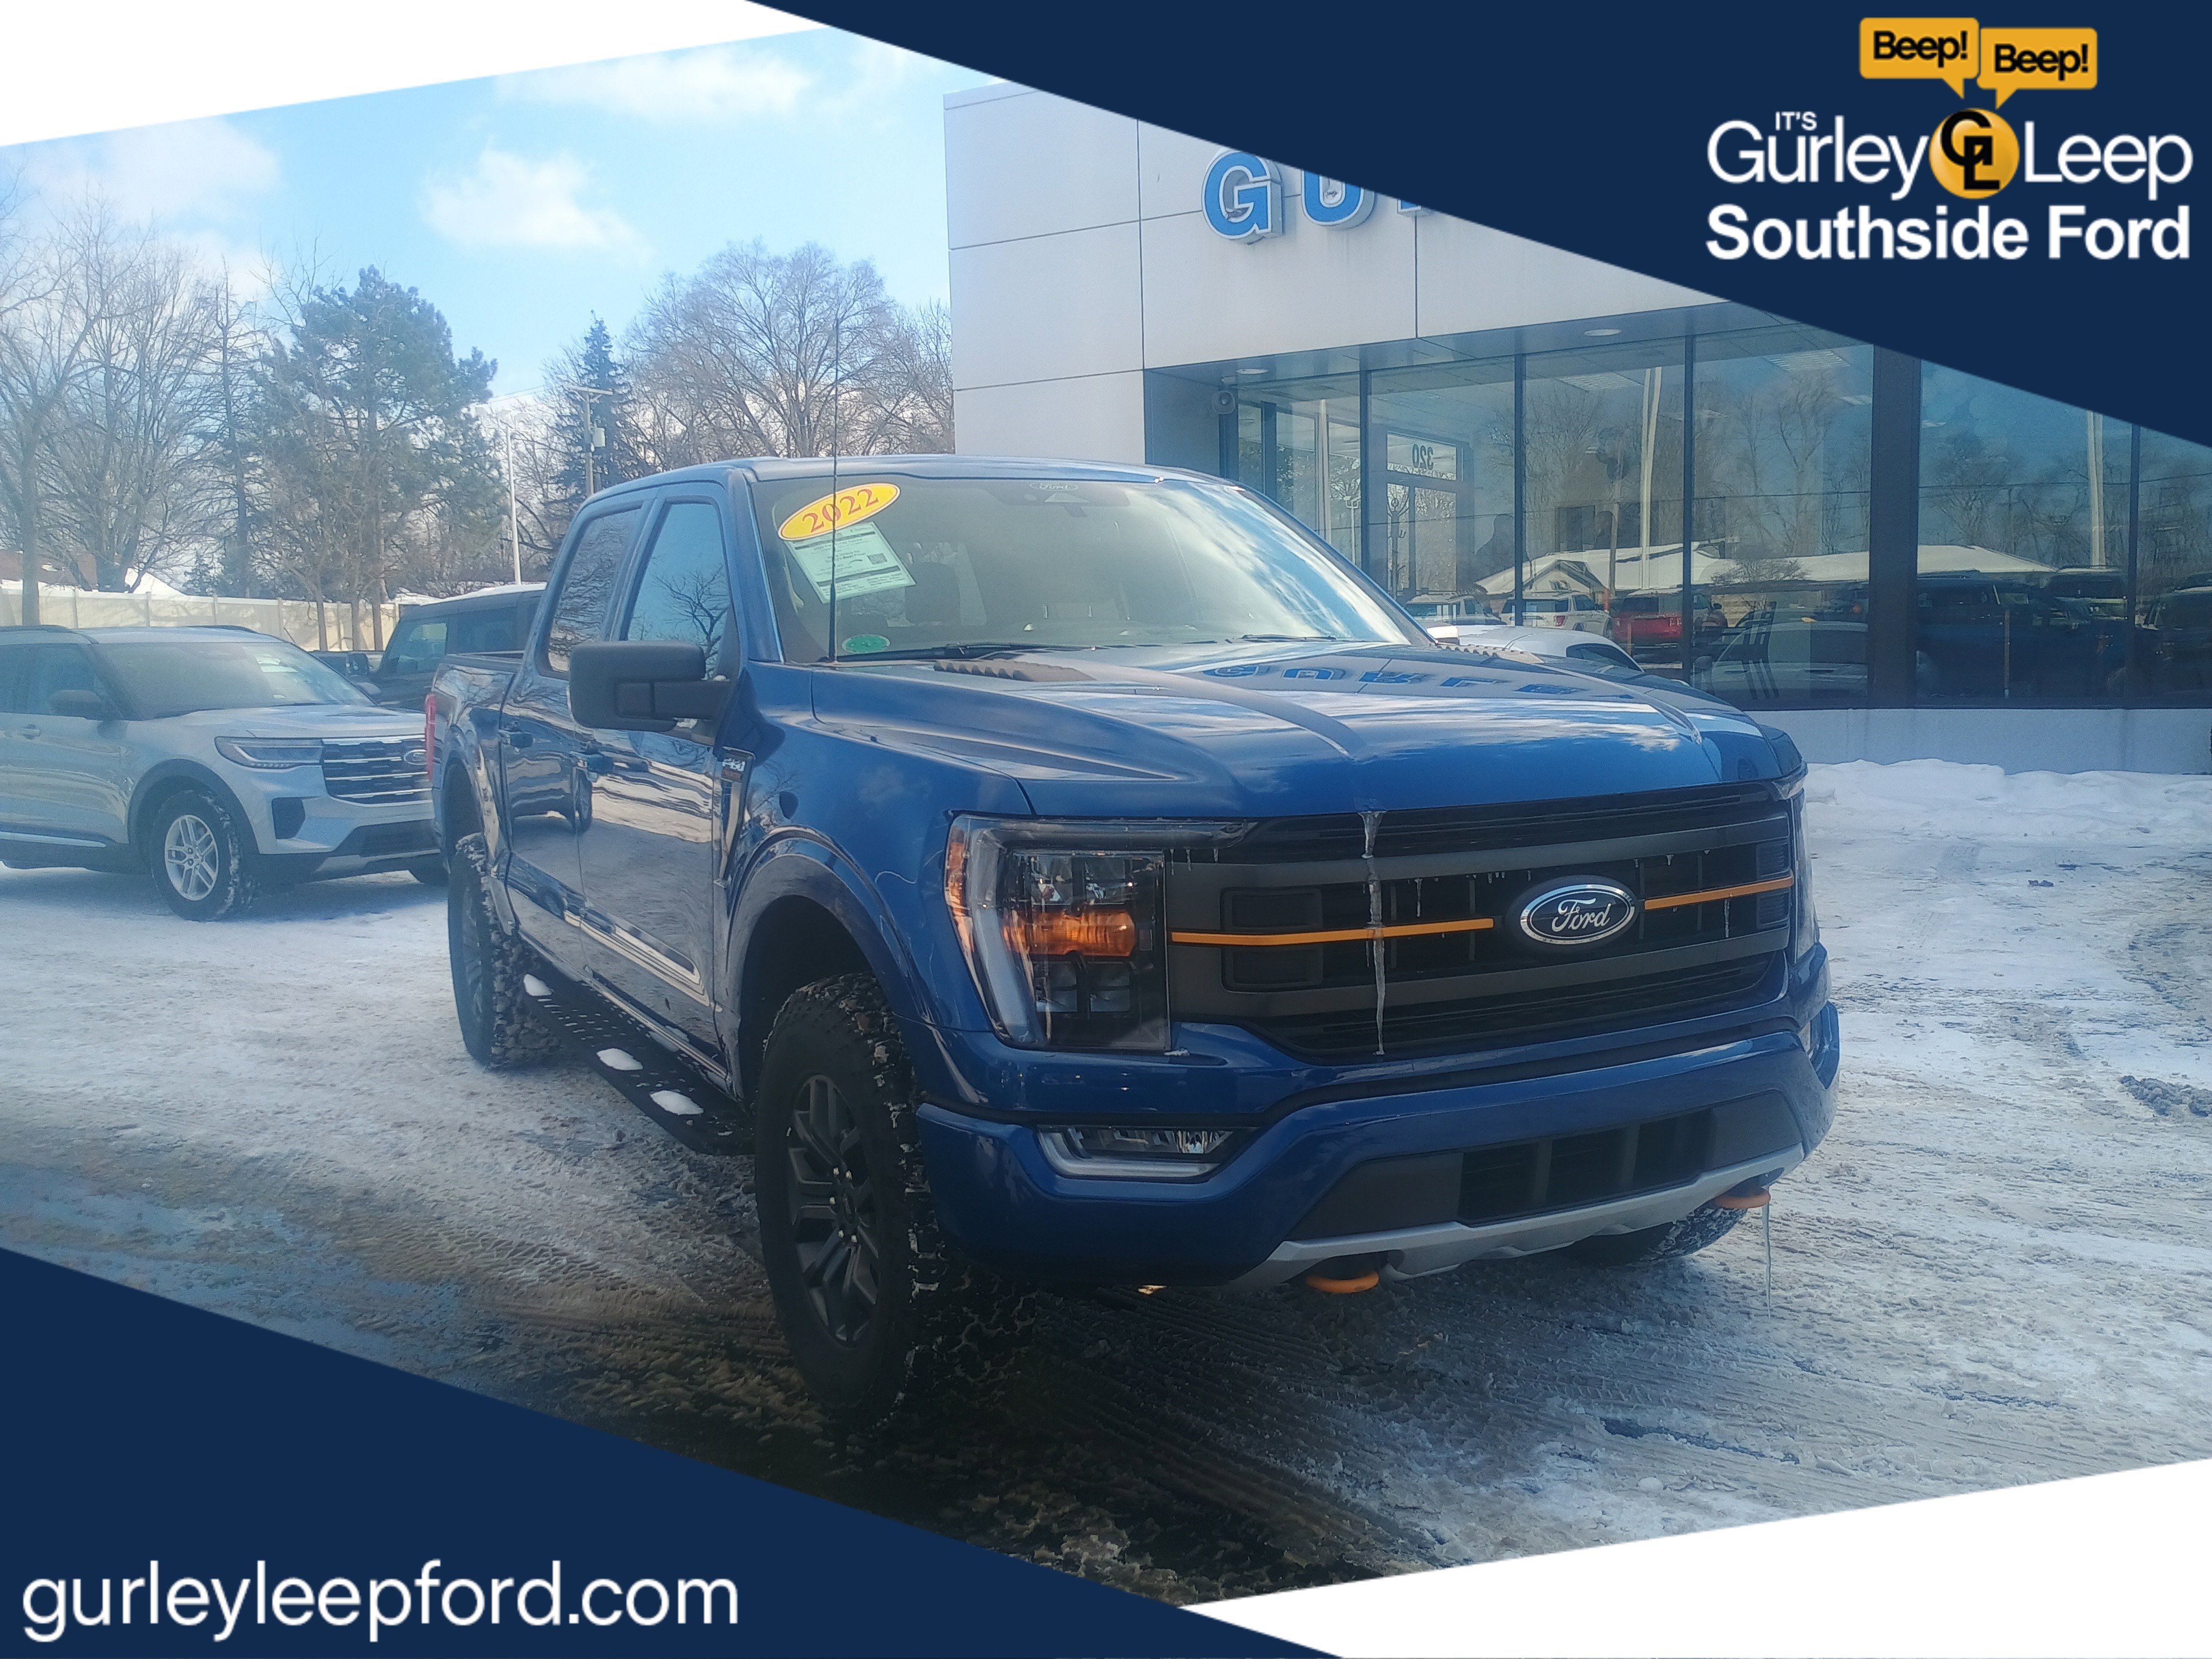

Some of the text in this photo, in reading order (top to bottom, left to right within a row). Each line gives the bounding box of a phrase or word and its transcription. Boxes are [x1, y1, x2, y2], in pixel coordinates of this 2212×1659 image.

[1201, 149, 1424, 242] GU
[802, 488, 879, 533] 2022
[1552, 898, 1612, 932] Ford
